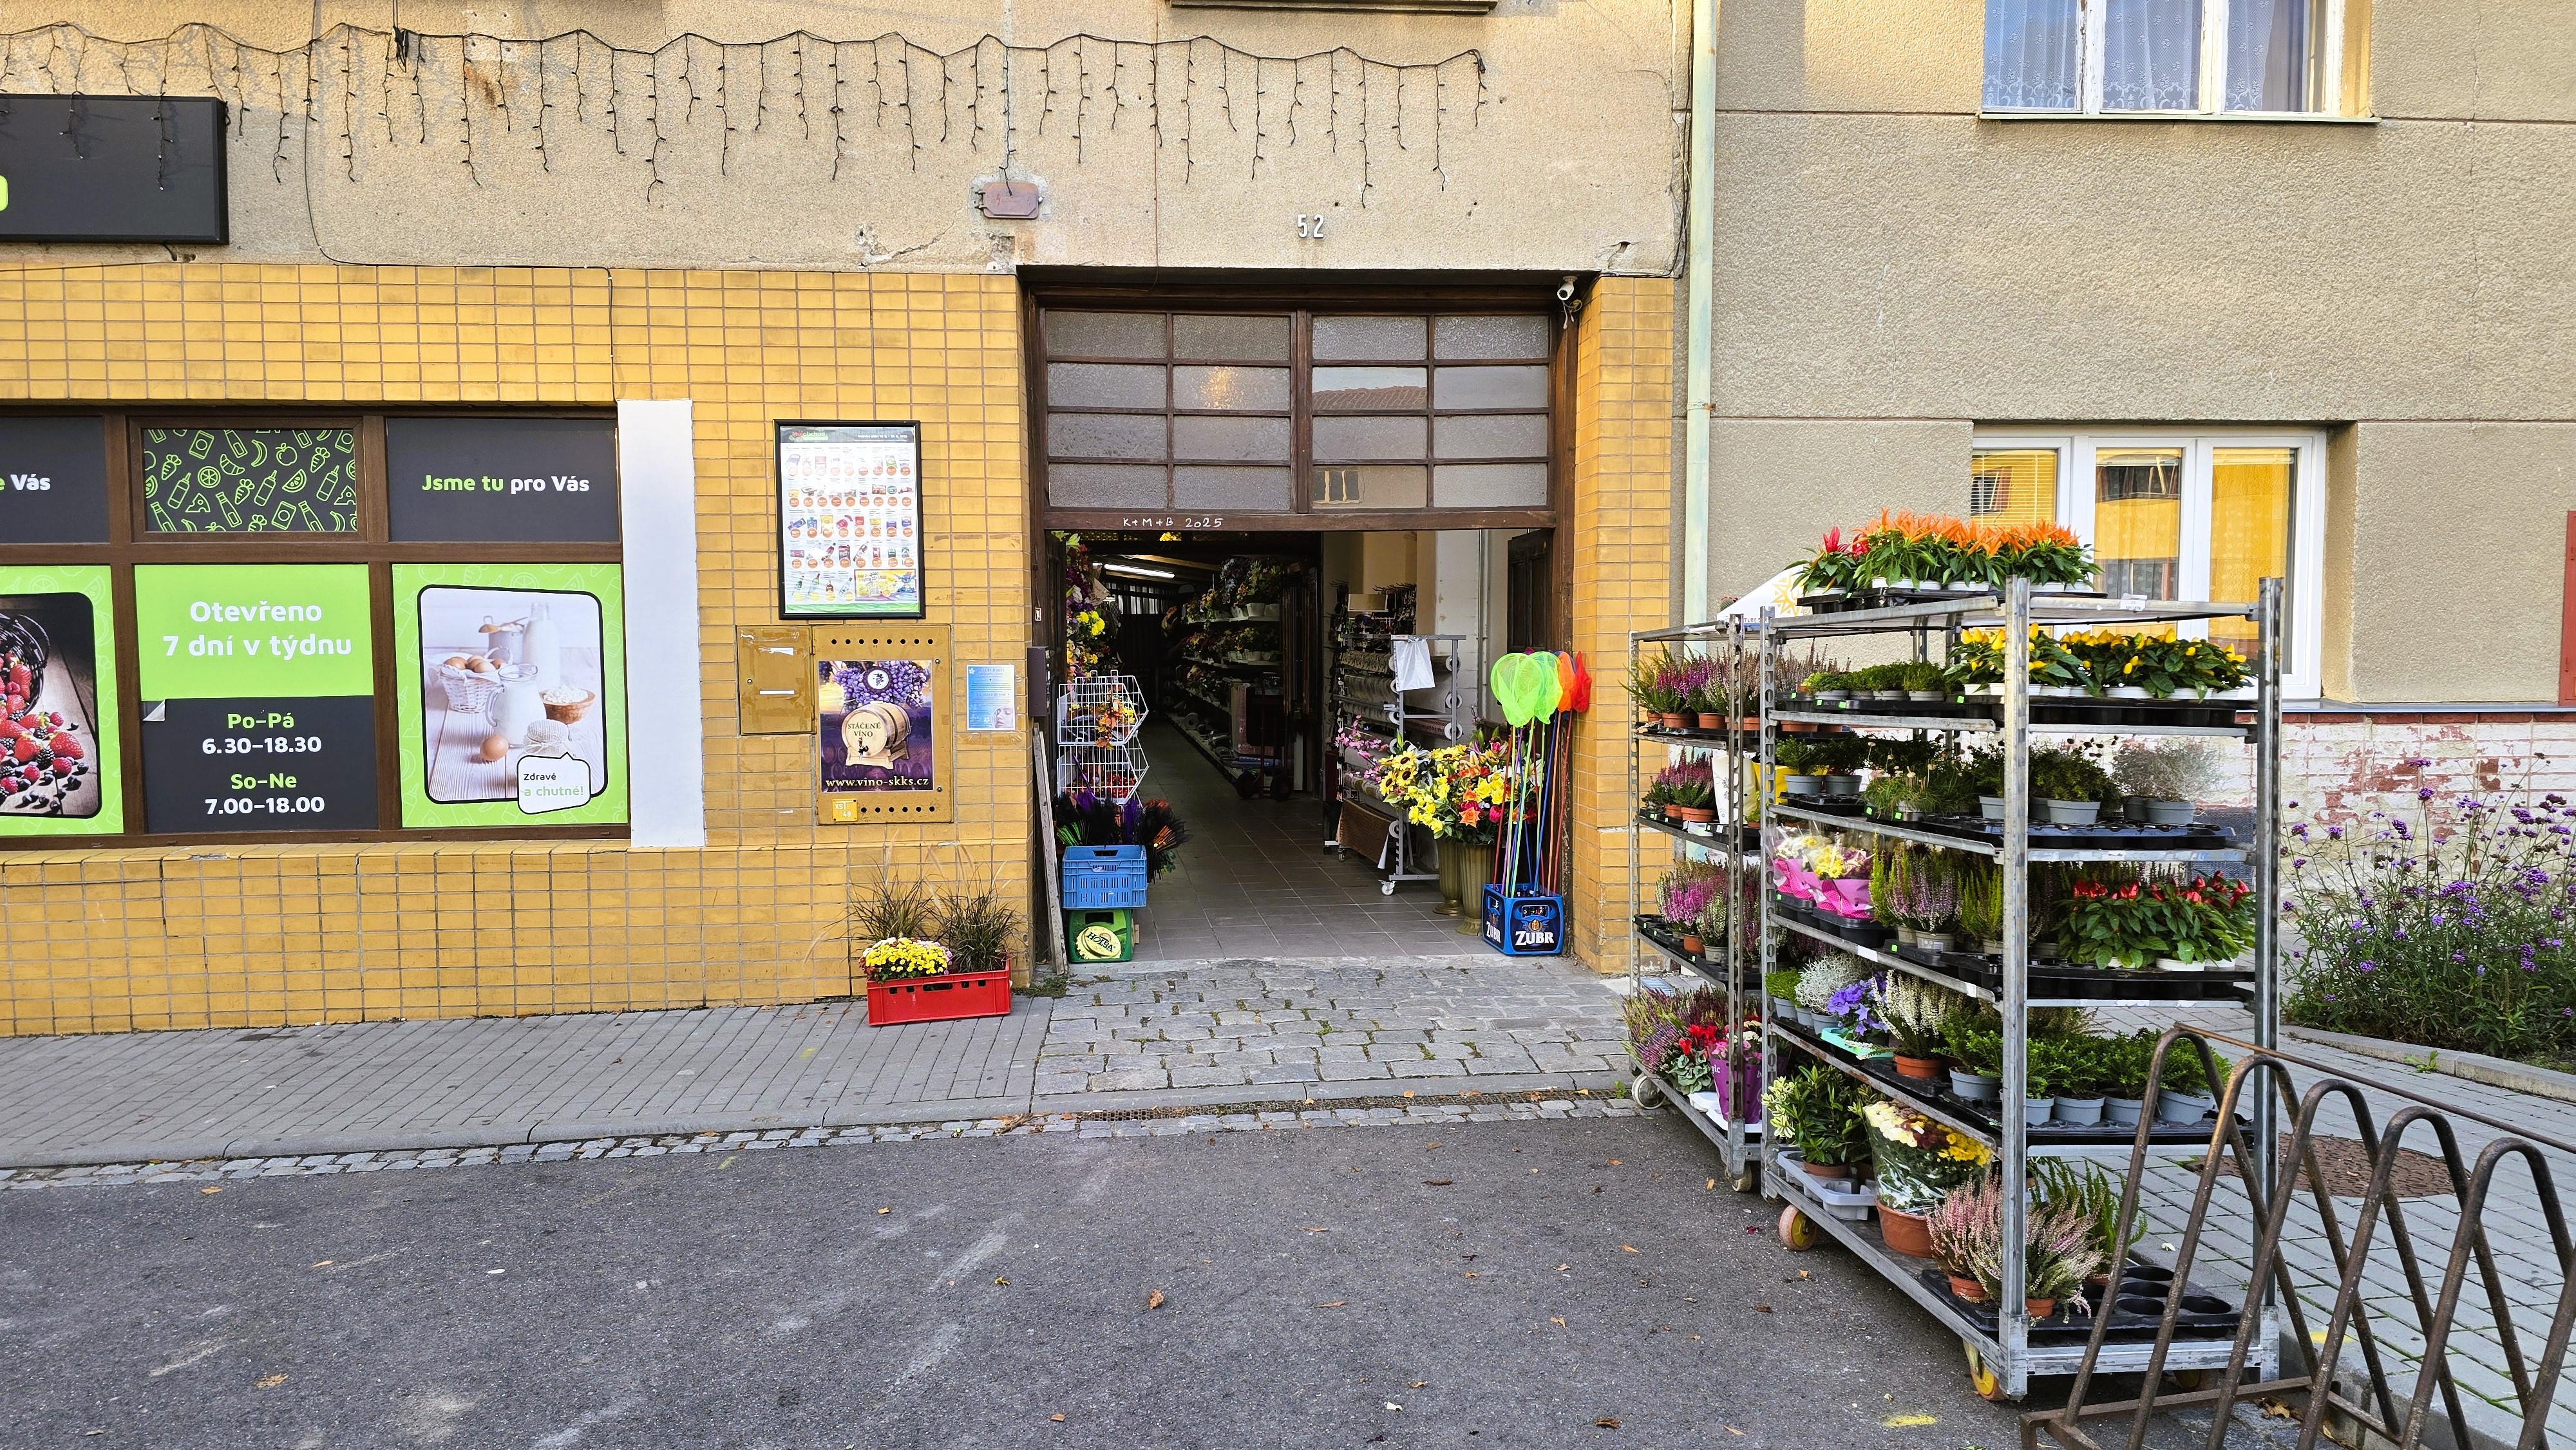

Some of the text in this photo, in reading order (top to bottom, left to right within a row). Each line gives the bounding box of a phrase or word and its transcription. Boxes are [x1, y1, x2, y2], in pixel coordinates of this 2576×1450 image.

[1297, 214, 1325, 239] 52
[10, 474, 51, 491] Vás
[422, 475, 590, 494] Jsme tu pro Vás
[1186, 517, 1224, 528] 2025
[190, 600, 322, 623] Otevřeno
[164, 635, 352, 661] 7 dní v týdnu
[536, 786, 584, 796] chutné!
[826, 776, 929, 787] www.vino-skks.cz
[1486, 921, 1501, 943] ZUBR
[1515, 930, 1555, 946] ZUBR
[1086, 932, 1113, 952] HOLBA
